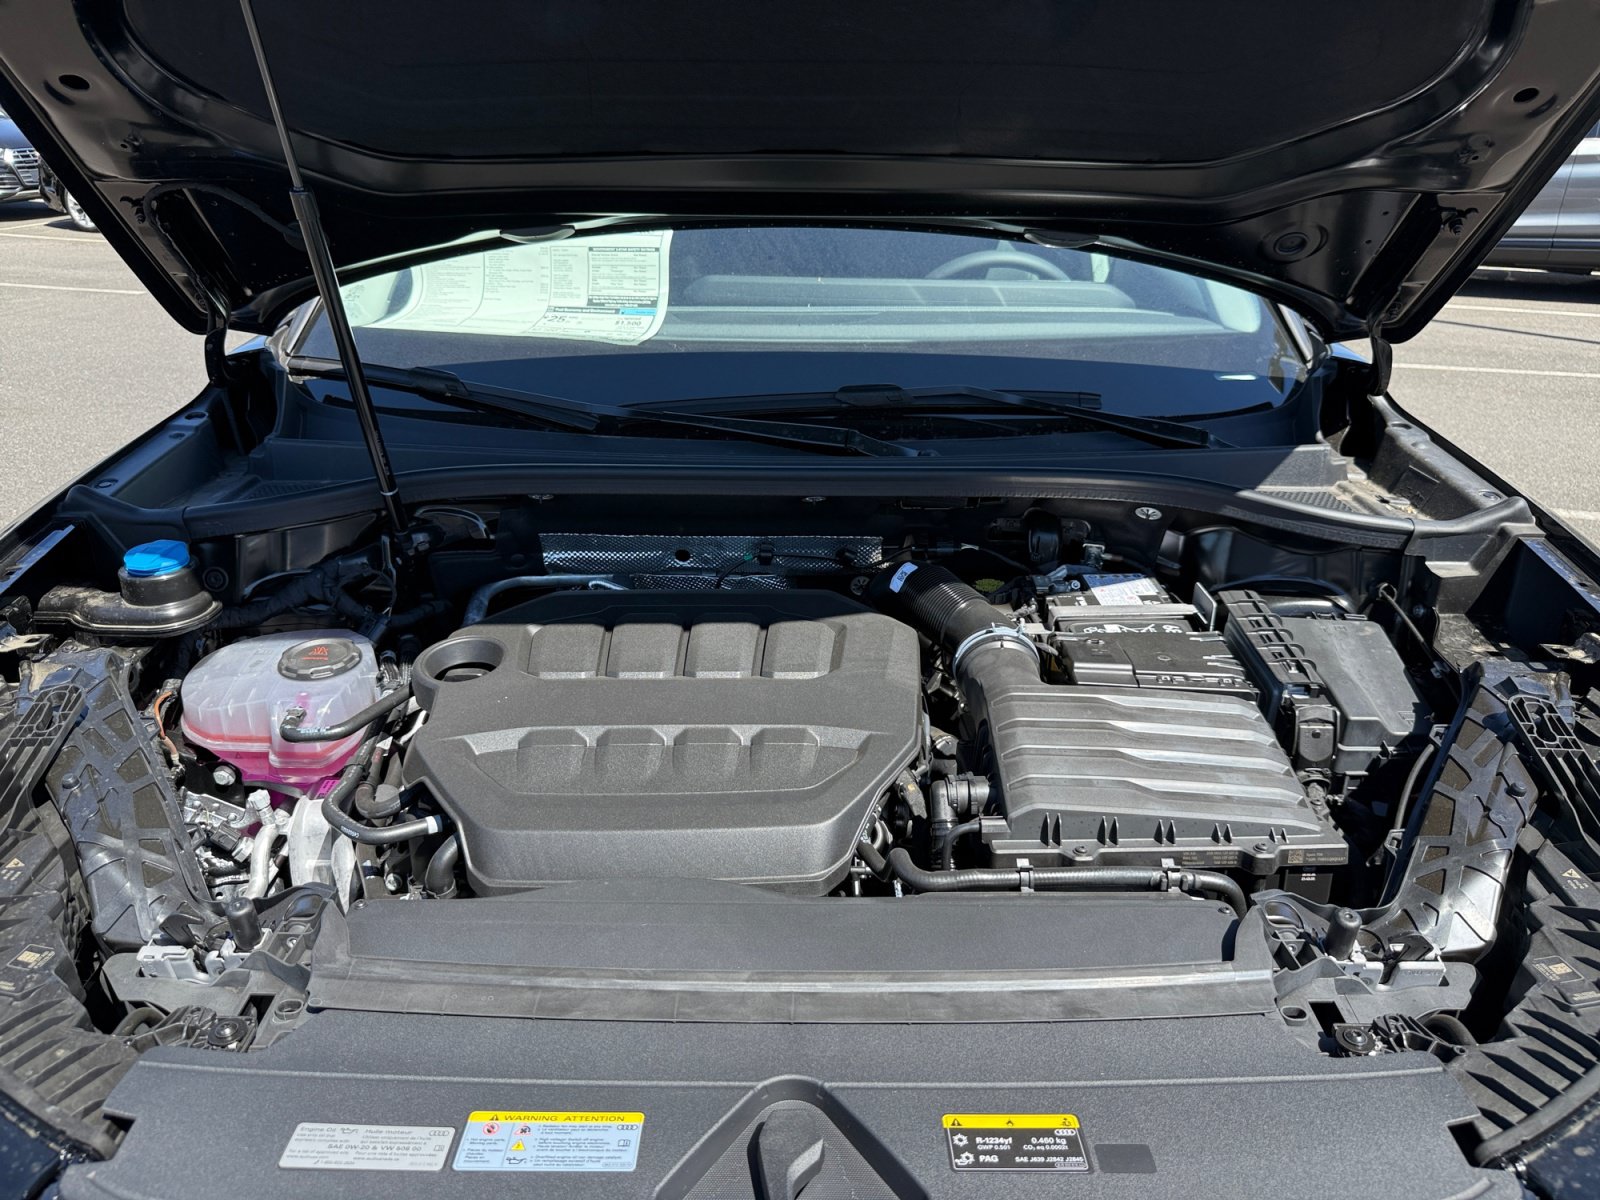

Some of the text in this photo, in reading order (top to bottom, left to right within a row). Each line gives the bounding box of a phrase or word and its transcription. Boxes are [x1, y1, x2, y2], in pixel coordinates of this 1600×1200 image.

[504, 1114, 558, 1122] WARNING
[975, 1136, 1013, 1145] R-1234yf
[1056, 1137, 1067, 1145] kg
[979, 1154, 999, 1163] PAG
